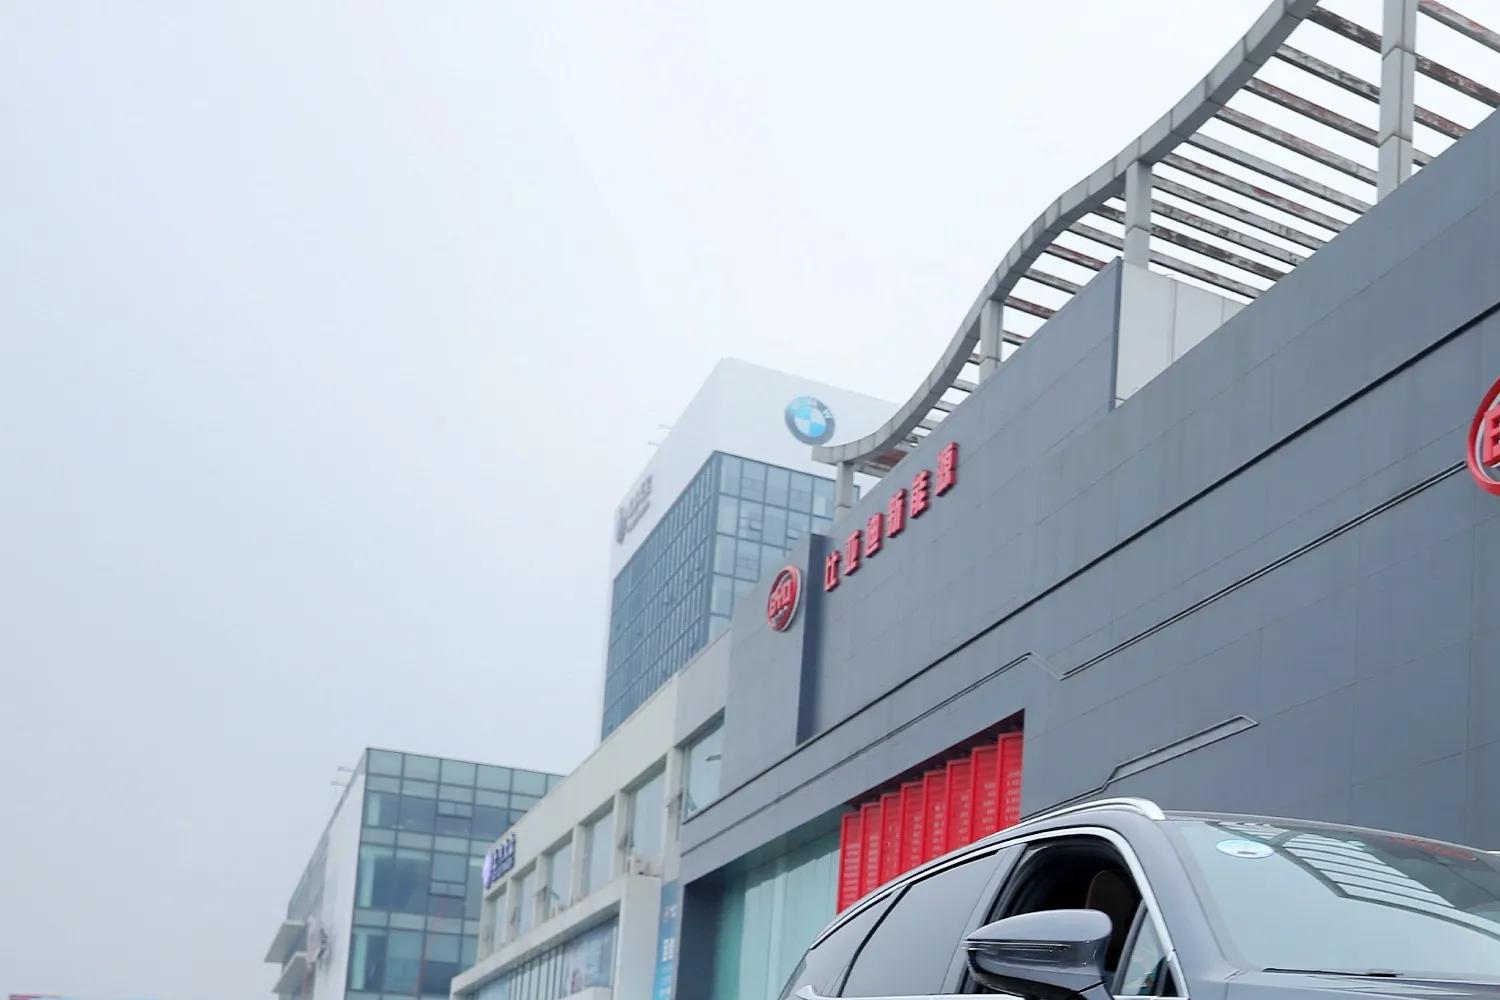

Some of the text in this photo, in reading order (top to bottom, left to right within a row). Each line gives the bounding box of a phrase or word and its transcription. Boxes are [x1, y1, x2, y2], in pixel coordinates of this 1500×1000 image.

[823, 441, 961, 593] 比亚迪新能源
[767, 579, 793, 619] BYD
